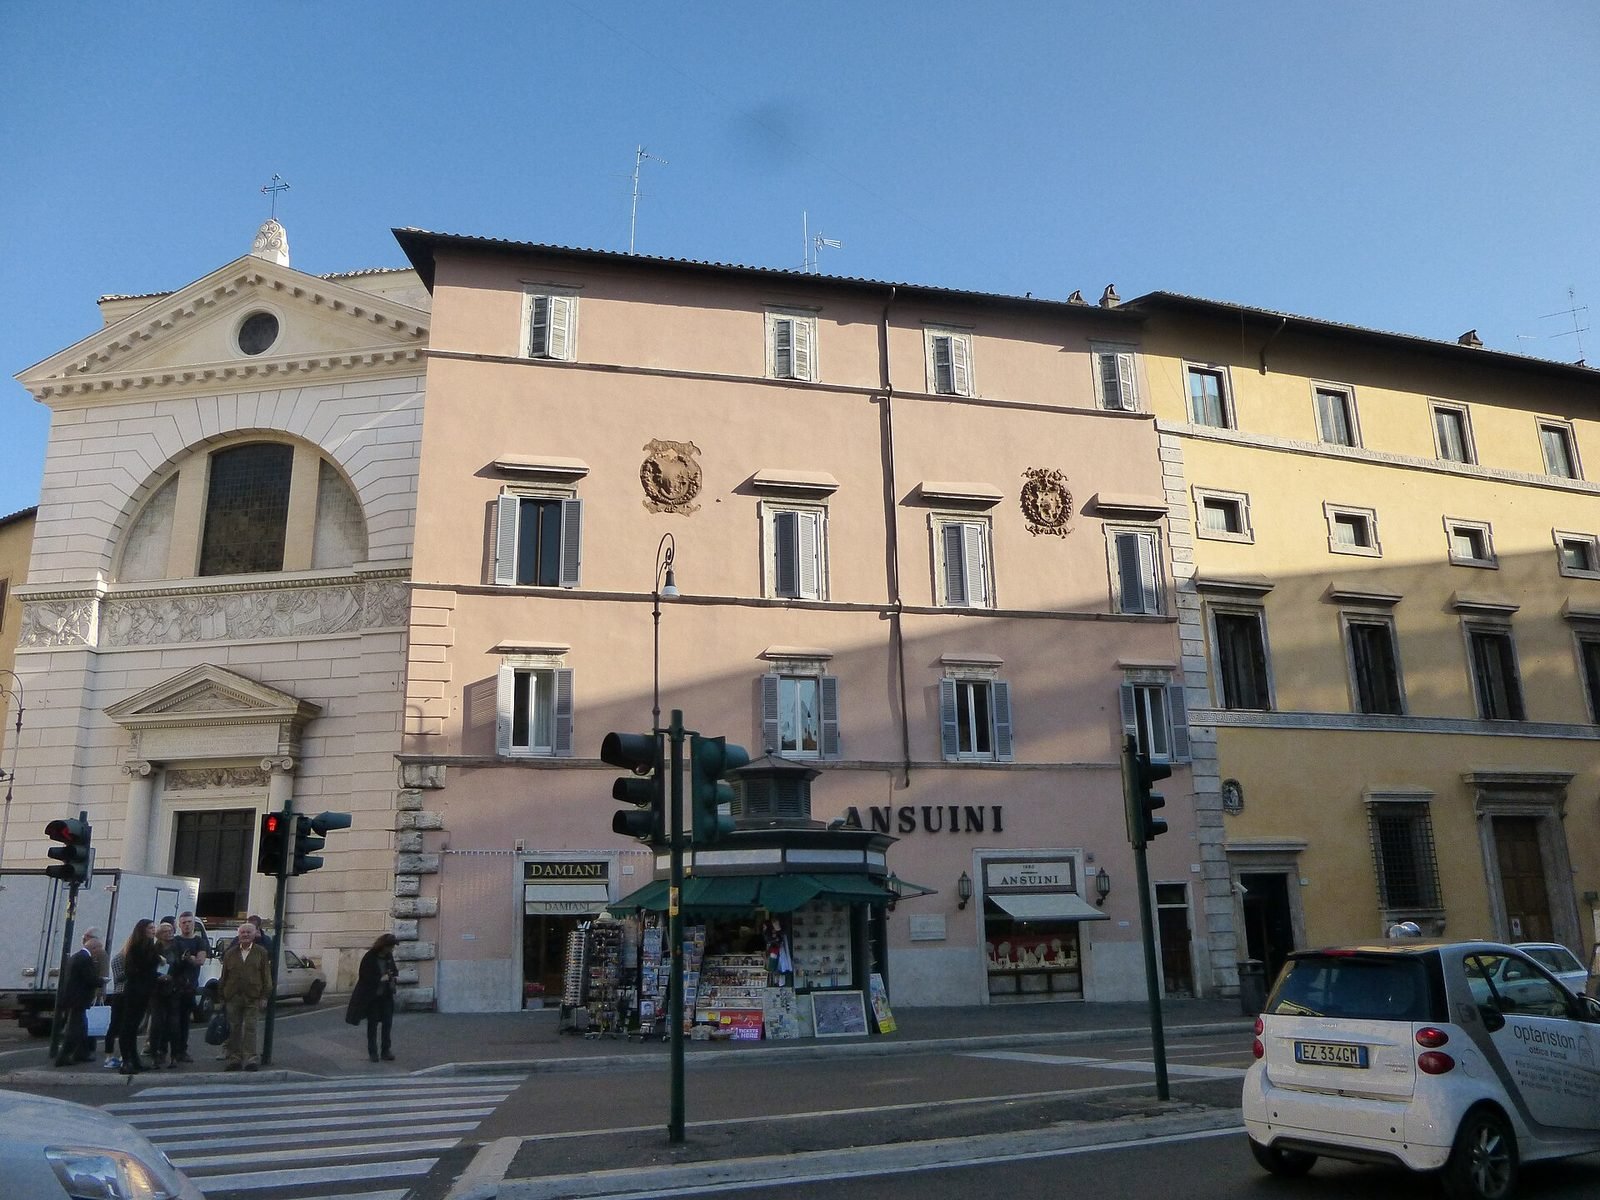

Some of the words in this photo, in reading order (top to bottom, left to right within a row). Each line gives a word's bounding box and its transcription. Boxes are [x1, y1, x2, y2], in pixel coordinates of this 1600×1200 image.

[846, 806, 1004, 833] ANSUINI
[531, 864, 602, 876] DAMIANI
[1001, 875, 1059, 885] ANSUINI
[544, 902, 590, 911] DAMIANI
[1513, 1025, 1576, 1050] optariston
[1303, 1045, 1317, 1060] EZ
[1320, 1046, 1358, 1063] 334GM
